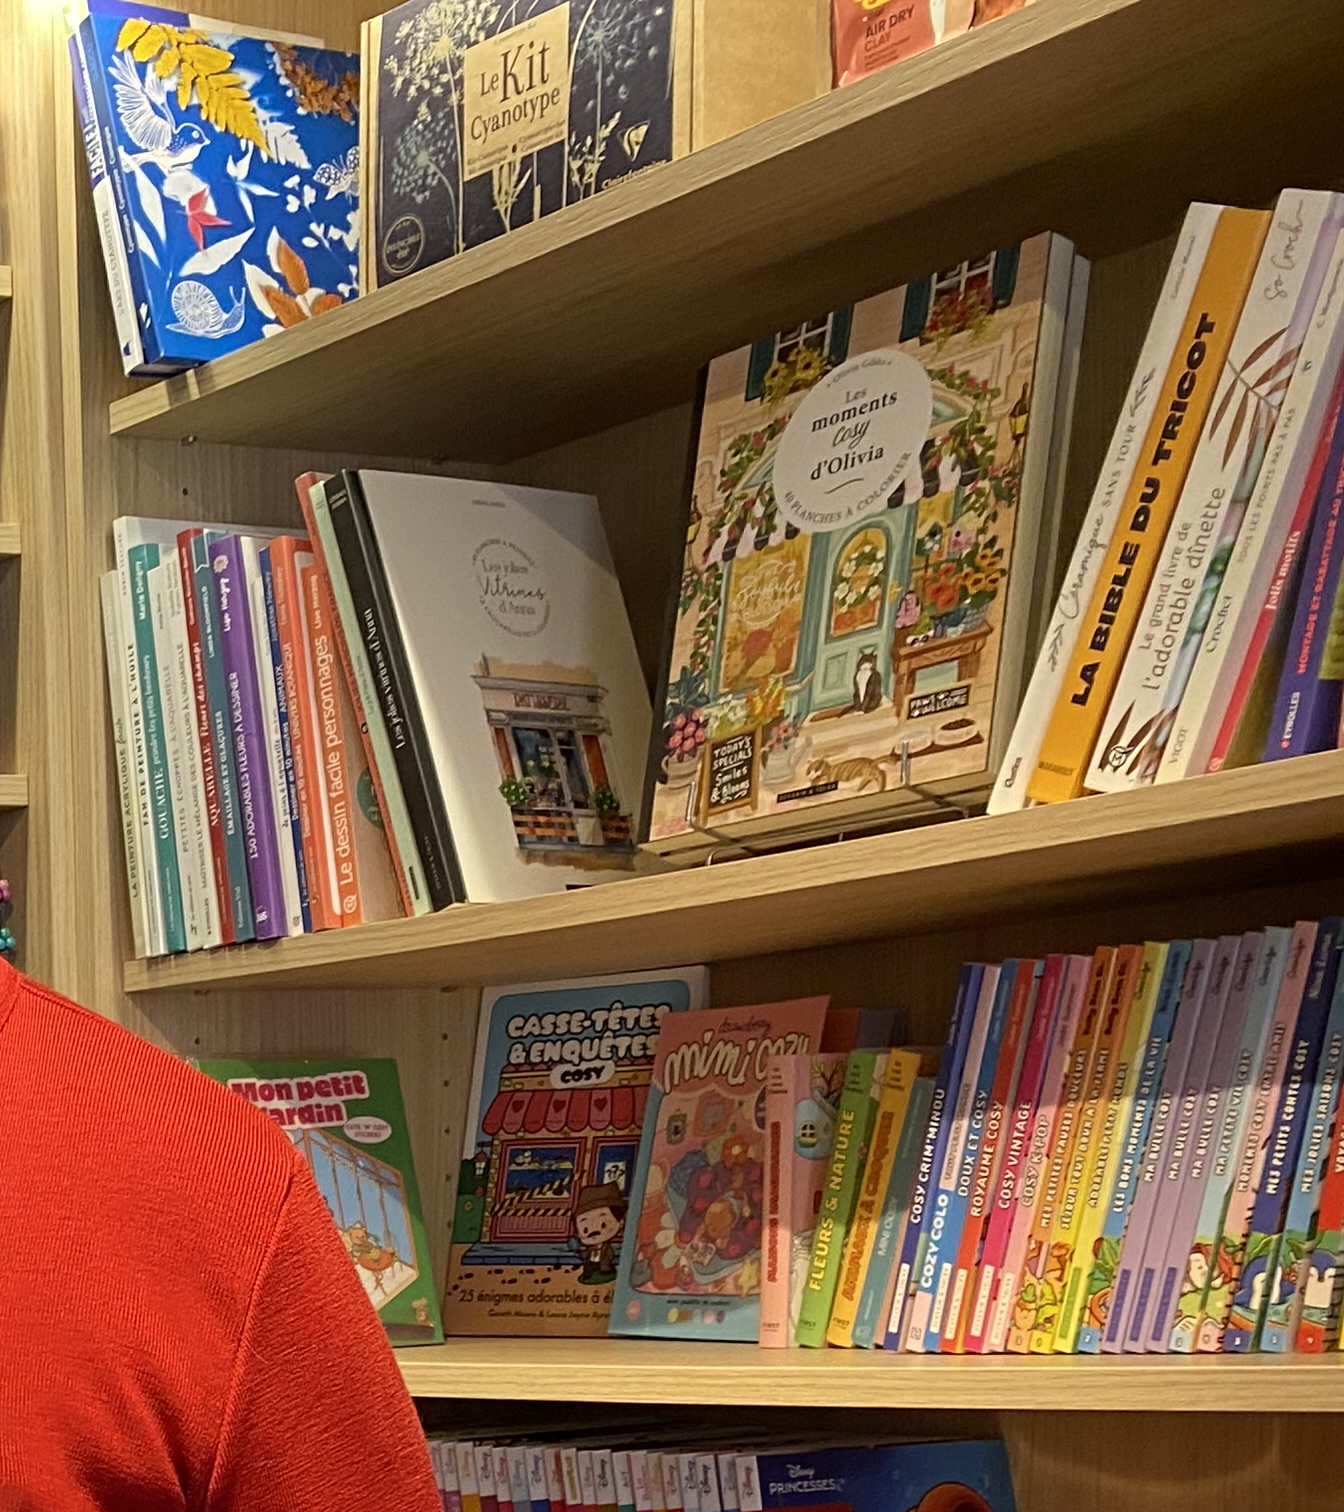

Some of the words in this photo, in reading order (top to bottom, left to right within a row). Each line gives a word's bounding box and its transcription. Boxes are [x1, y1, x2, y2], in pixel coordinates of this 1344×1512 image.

[865, 21, 886, 40] AIR
[889, 5, 915, 28] DRY
[865, 31, 892, 51] CLAY
[480, 72, 499, 97] Le
[500, 41, 550, 104] Kit
[470, 87, 560, 144] Cyanotype
[812, 391, 898, 433] moments
[845, 387, 868, 404] Les
[790, 500, 842, 524] PLANCHES
[845, 505, 854, 517] À
[856, 451, 912, 512] COLORIER
[810, 445, 885, 481] d'Olivia
[1070, 660, 1102, 707] LA
[1089, 540, 1142, 652] BIBLE
[1130, 477, 1161, 533] DU
[1151, 312, 1216, 467] TRICOT
[1138, 633, 1155, 651] Le
[1149, 584, 1173, 628] grand
[1164, 540, 1184, 580] livre
[1176, 521, 1193, 541] de
[1142, 576, 1197, 691] l'adorable
[1186, 486, 1226, 570] dînette
[229, 671, 243, 723] DESSINER
[315, 635, 343, 748] personnages
[236, 734, 250, 773] FLEURS
[326, 748, 344, 800] facile
[713, 748, 753, 771] SPECIALS
[153, 768, 169, 841] GOUACHE
[239, 771, 258, 838] ADORABLES
[332, 800, 352, 859] dessin
[249, 843, 260, 860] 150
[340, 862, 355, 886] Le
[507, 1000, 672, 1038] CASSE-TÊTES
[508, 1042, 528, 1065] &
[529, 1030, 660, 1065] ENQUÊTES
[231, 1081, 294, 1103] Mon
[296, 1074, 366, 1101] petit
[560, 1064, 607, 1084] COSY
[265, 1101, 344, 1127] ardin
[918, 1088, 946, 1184] CRIM'MINOU
[830, 1109, 856, 1192] NATURE
[970, 1143, 997, 1218] ROYAUME
[987, 1100, 1005, 1141] COSY
[998, 1169, 1017, 1210] COSY
[1008, 1101, 1034, 1167] VINTAGE
[824, 1192, 839, 1212] &
[910, 1184, 927, 1225] COSY
[930, 1194, 950, 1241] COLO
[809, 1216, 834, 1292] FLEURS
[921, 1236, 942, 1290] COZY
